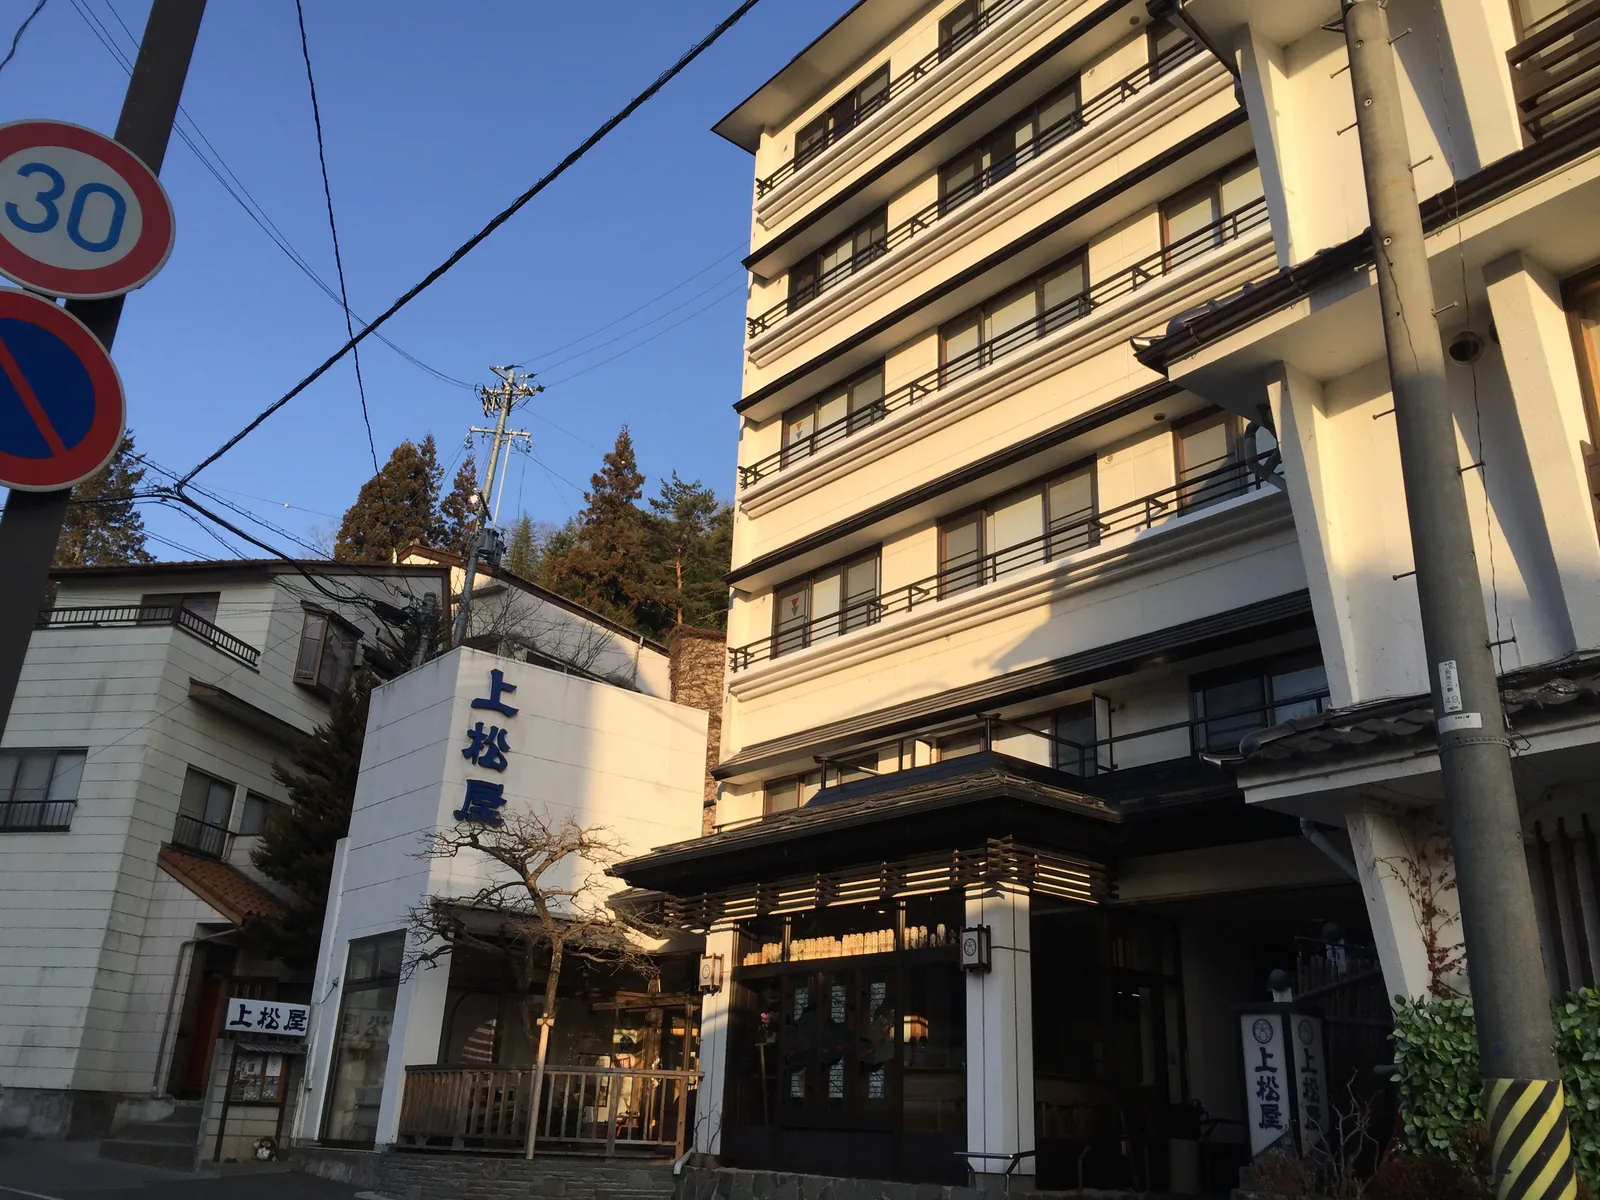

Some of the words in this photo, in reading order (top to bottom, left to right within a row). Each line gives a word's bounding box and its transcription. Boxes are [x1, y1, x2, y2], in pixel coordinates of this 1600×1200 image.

[6, 163, 127, 252] 30
[453, 669, 519, 827] 上松屋
[229, 1004, 307, 1031] 上松屋
[1254, 1047, 1283, 1130] 上松屋
